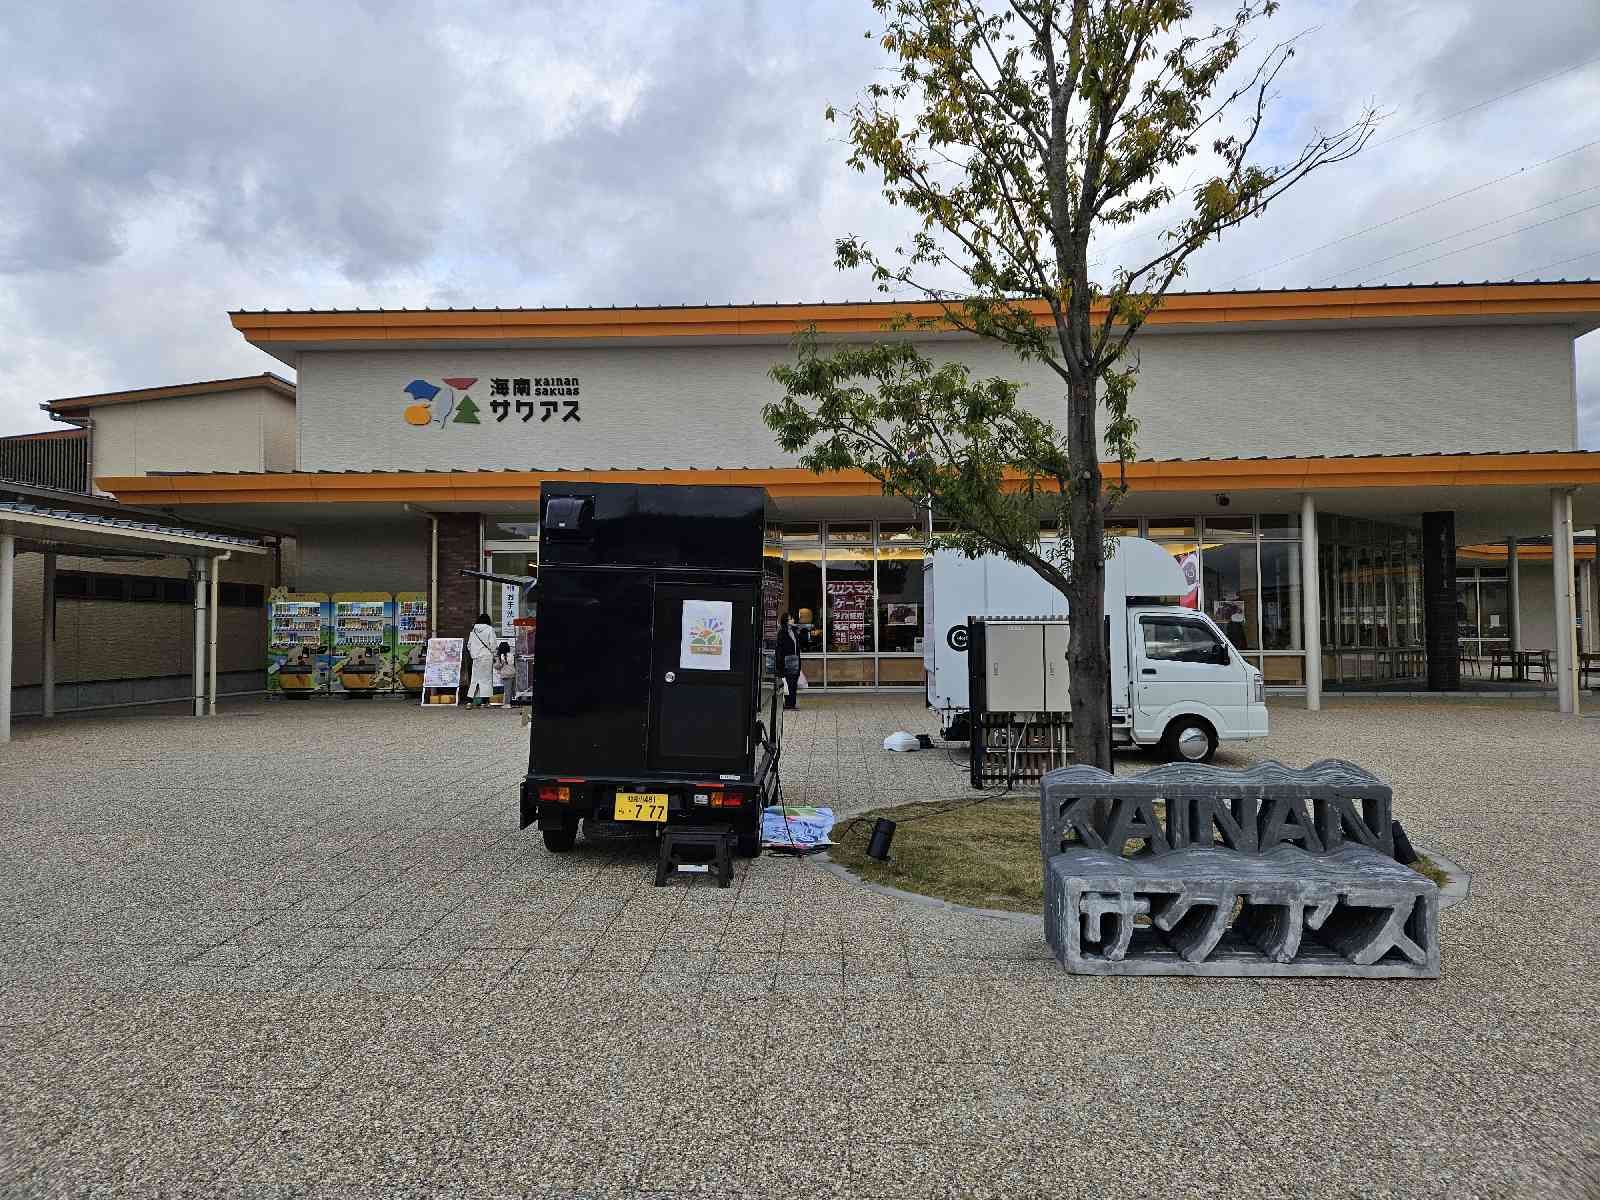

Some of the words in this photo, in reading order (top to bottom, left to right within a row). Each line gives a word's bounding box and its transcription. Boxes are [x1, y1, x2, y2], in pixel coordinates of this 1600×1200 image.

[490, 377, 531, 396] 海南
[827, 583, 874, 594] クリスマス
[1045, 796, 1394, 853] KAINAN
[1078, 887, 1428, 965] サクアス
